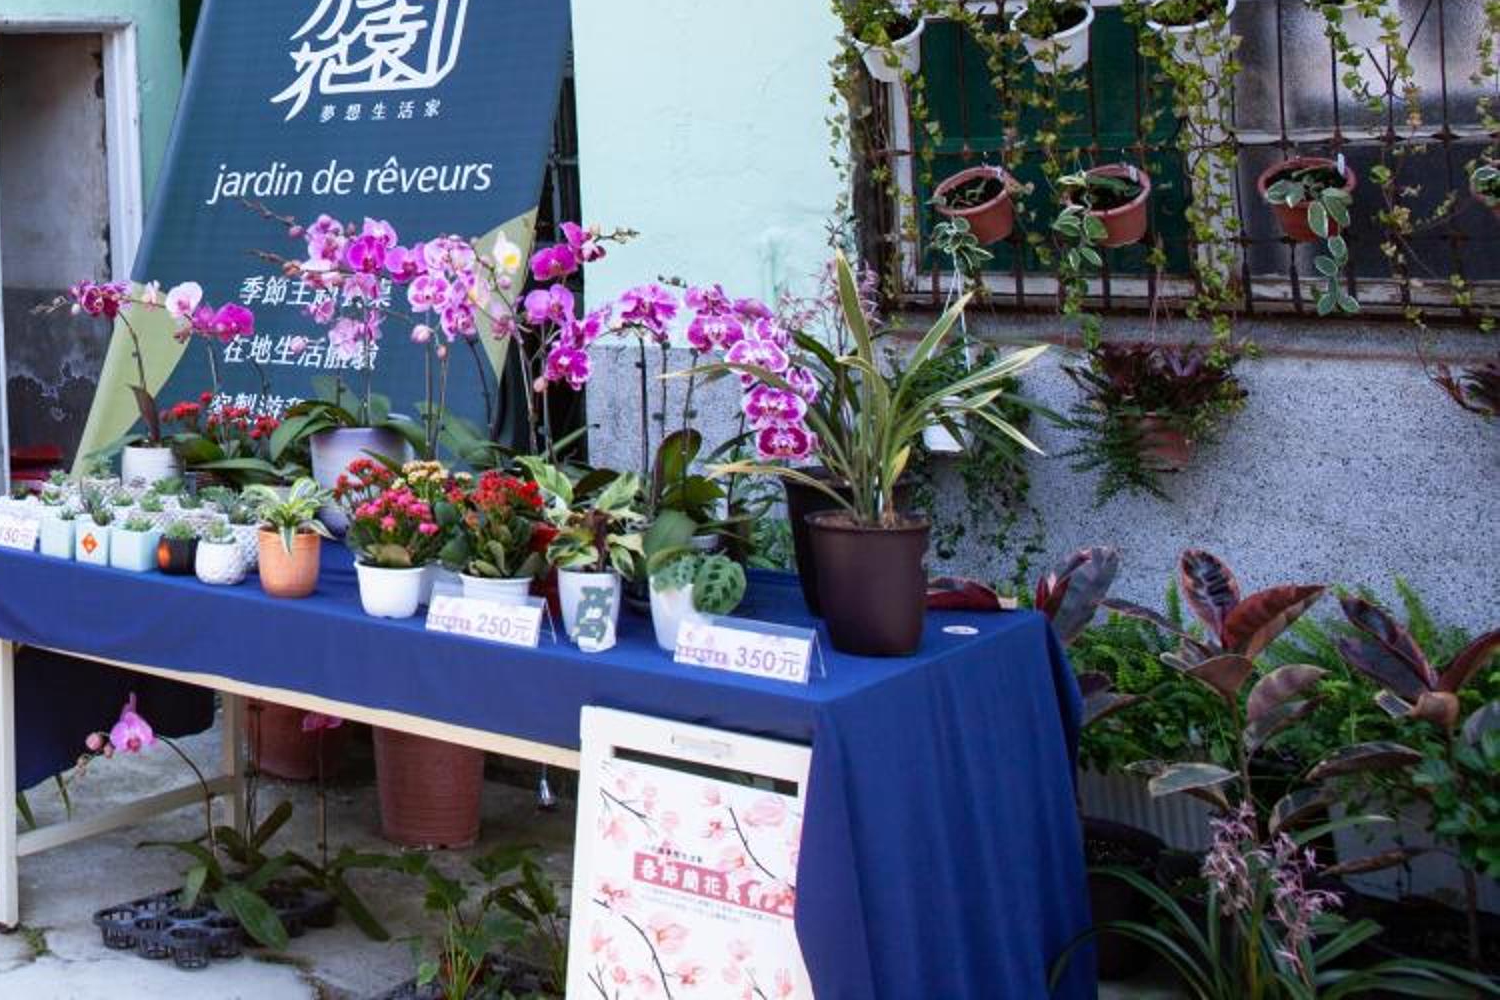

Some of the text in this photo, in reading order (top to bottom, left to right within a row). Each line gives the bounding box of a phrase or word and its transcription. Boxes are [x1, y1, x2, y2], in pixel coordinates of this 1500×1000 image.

[319, 99, 441, 123] 夢想生活家
[205, 155, 493, 205] jardin de rêveurs
[476, 613, 534, 642] 250元
[734, 646, 802, 677] 350元
